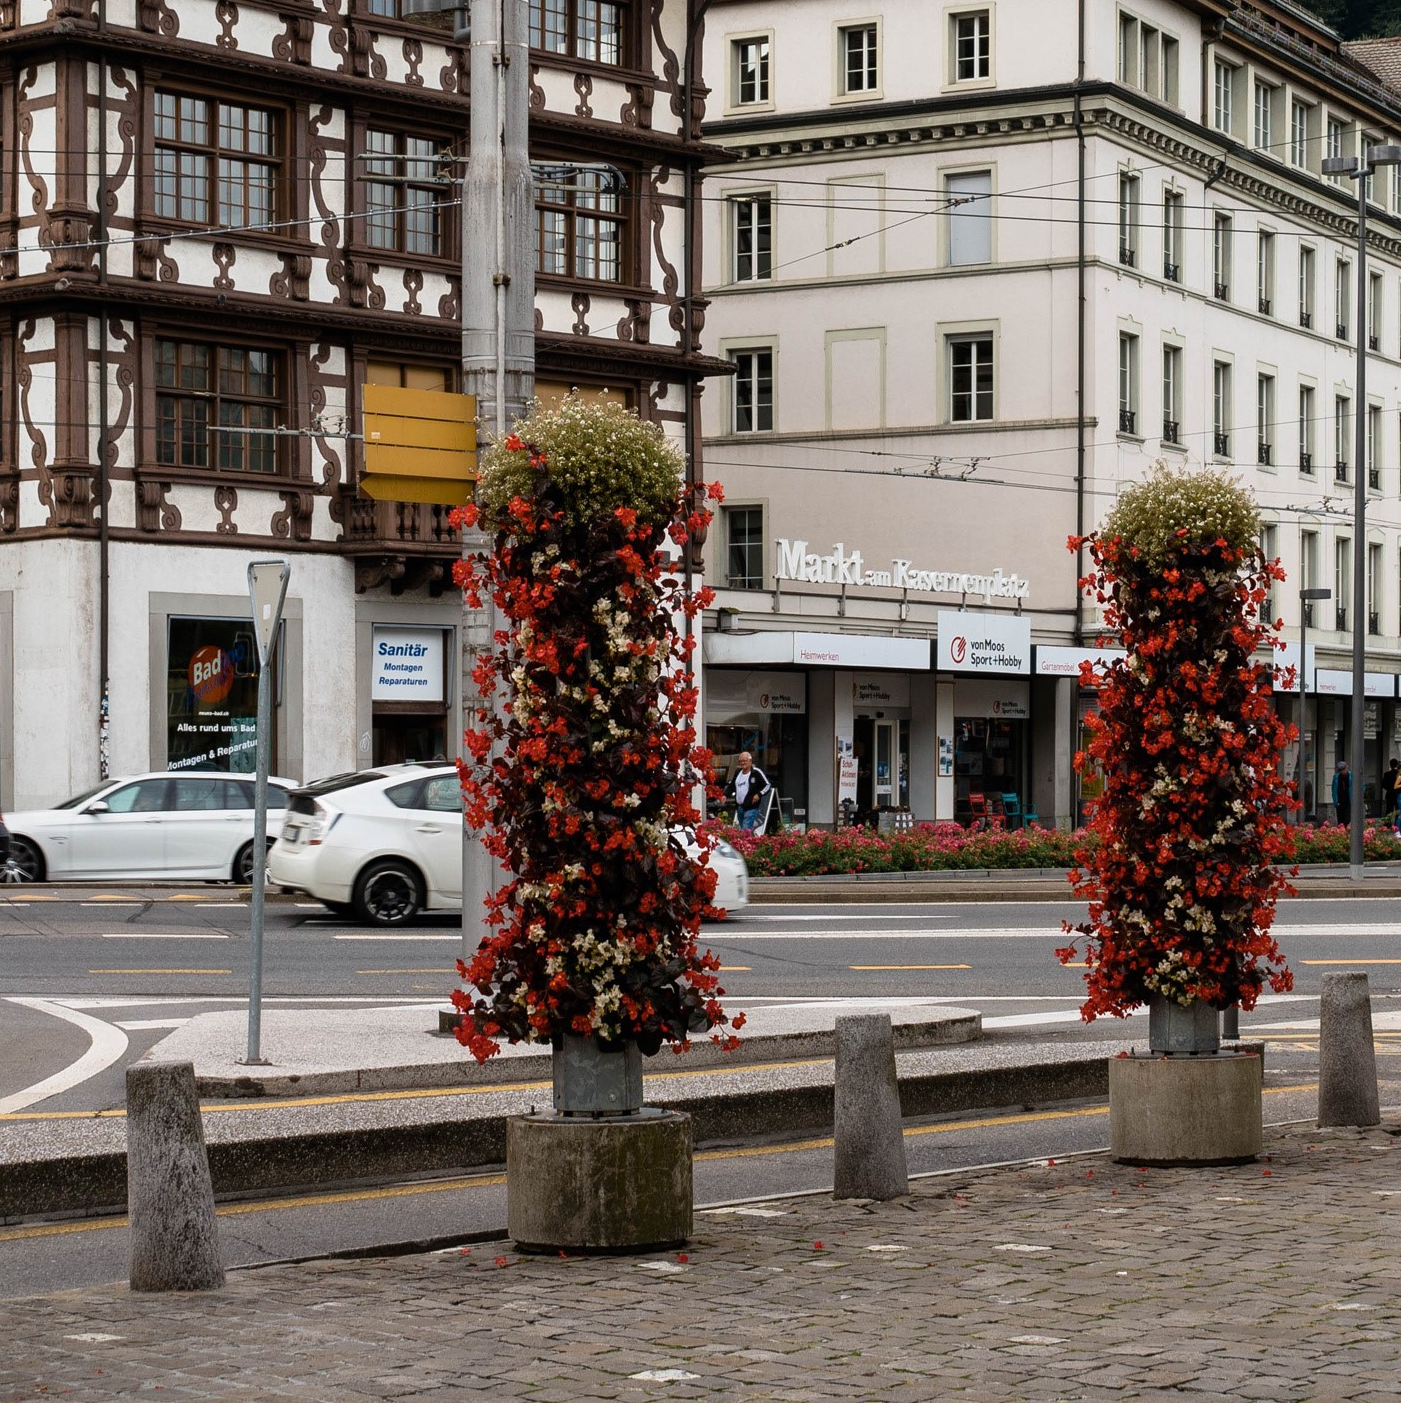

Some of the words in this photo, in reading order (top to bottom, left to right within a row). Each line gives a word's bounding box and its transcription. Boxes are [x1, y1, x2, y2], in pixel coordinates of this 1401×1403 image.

[774, 538, 864, 586] Markt
[864, 570, 892, 587] am
[892, 558, 1030, 605] Kasernenplatz
[378, 642, 428, 656] Sanitär
[800, 649, 840, 661] Heimwerken
[193, 649, 222, 686] Bad
[384, 662, 423, 672] Montagen
[1041, 660, 1074, 672] Gartenmöbel
[378, 676, 428, 686] Reparaturen
[177, 724, 197, 732] Alles
[200, 724, 219, 732] rund
[240, 724, 256, 732] Bad
[209, 750, 215, 759] &
